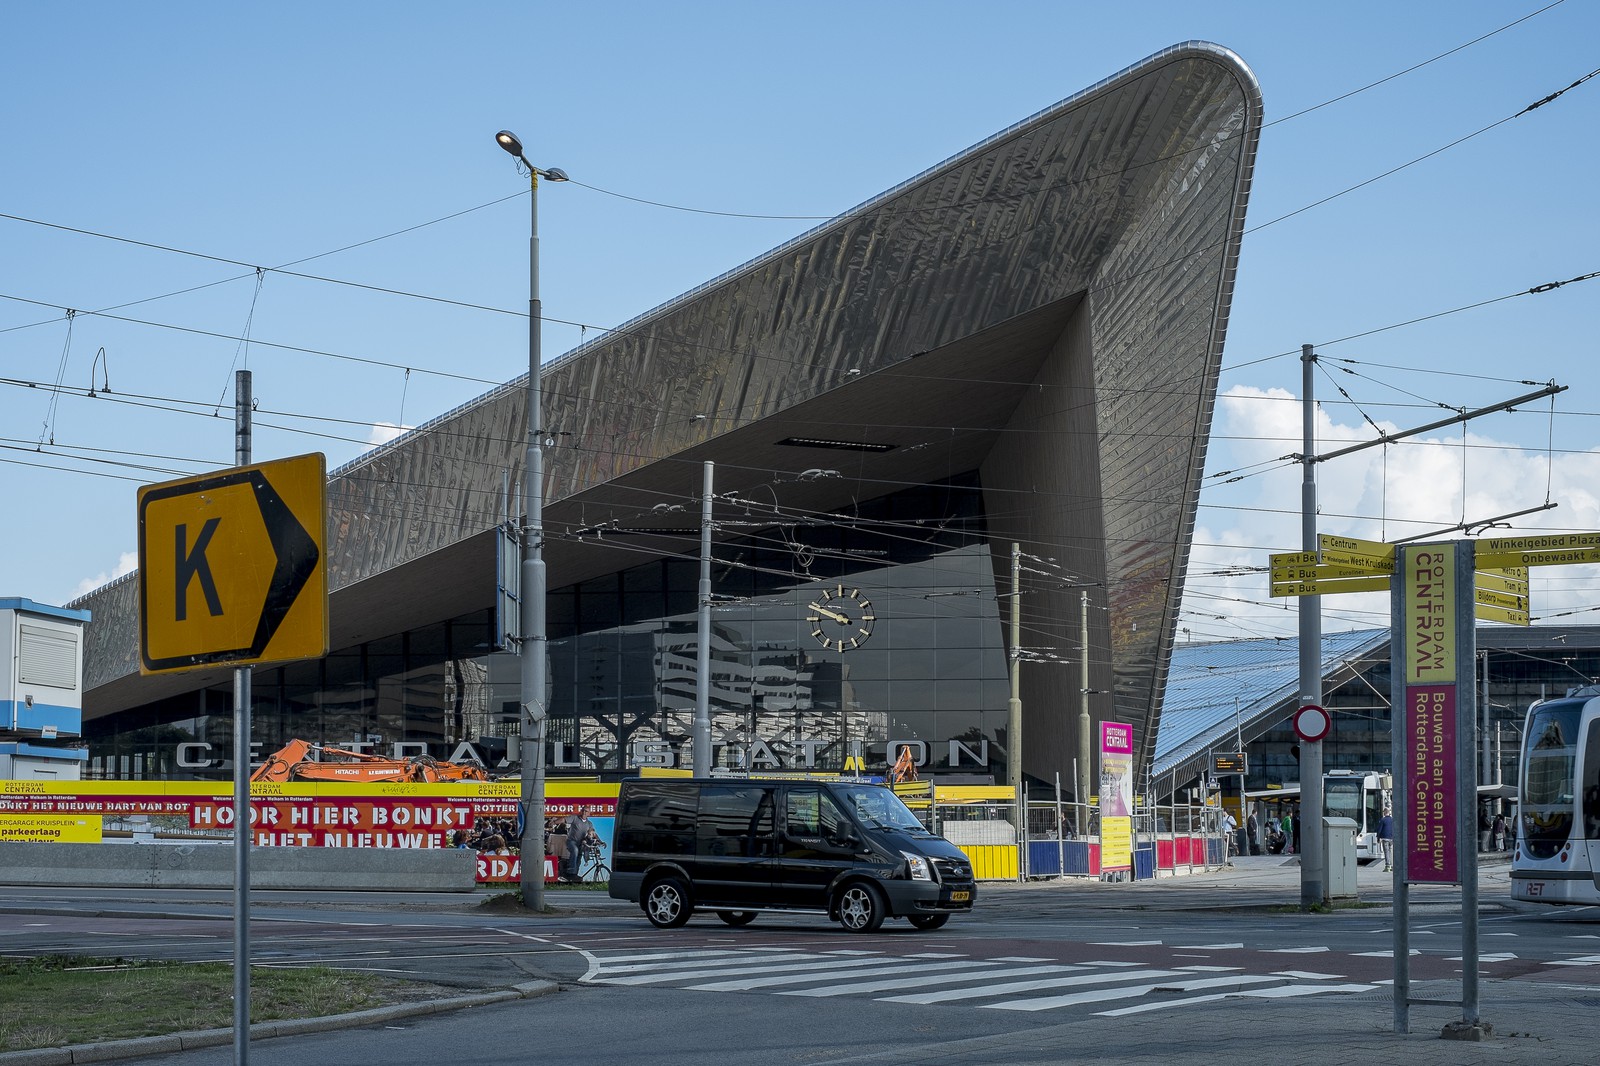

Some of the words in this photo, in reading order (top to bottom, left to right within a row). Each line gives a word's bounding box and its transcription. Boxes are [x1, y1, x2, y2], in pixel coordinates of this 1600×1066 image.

[1330, 538, 1358, 550] Centrum
[1490, 536, 1565, 549] Winkelgebied
[1569, 536, 1600, 544] Plaza
[1350, 556, 1364, 566] West
[1366, 558, 1394, 570] Kruiskade
[1522, 552, 1585, 562] Onbewaakt
[175, 517, 224, 622] K
[1299, 570, 1316, 578] Bus
[1299, 584, 1316, 592] Bus
[1504, 580, 1516, 590] Tram
[1416, 552, 1432, 678] CENTRAAL
[1434, 553, 1444, 669] ROTTERDAM
[1507, 612, 1517, 620] Taxi
[1434, 693, 1446, 753] Bouwen
[1416, 694, 1428, 776] Rotterdam
[1434, 760, 1443, 786] aan
[32, 802, 54, 810] HET
[1434, 794, 1444, 820] een
[291, 807, 359, 825] HIER
[372, 807, 470, 825] BONKT
[1416, 780, 1429, 852] Centraal!
[2, 828, 60, 837] parkeerlaag
[259, 833, 312, 847] HET
[324, 833, 442, 848] NIEUWE
[1434, 826, 1446, 870] nieuw
[1526, 882, 1545, 896] RET
